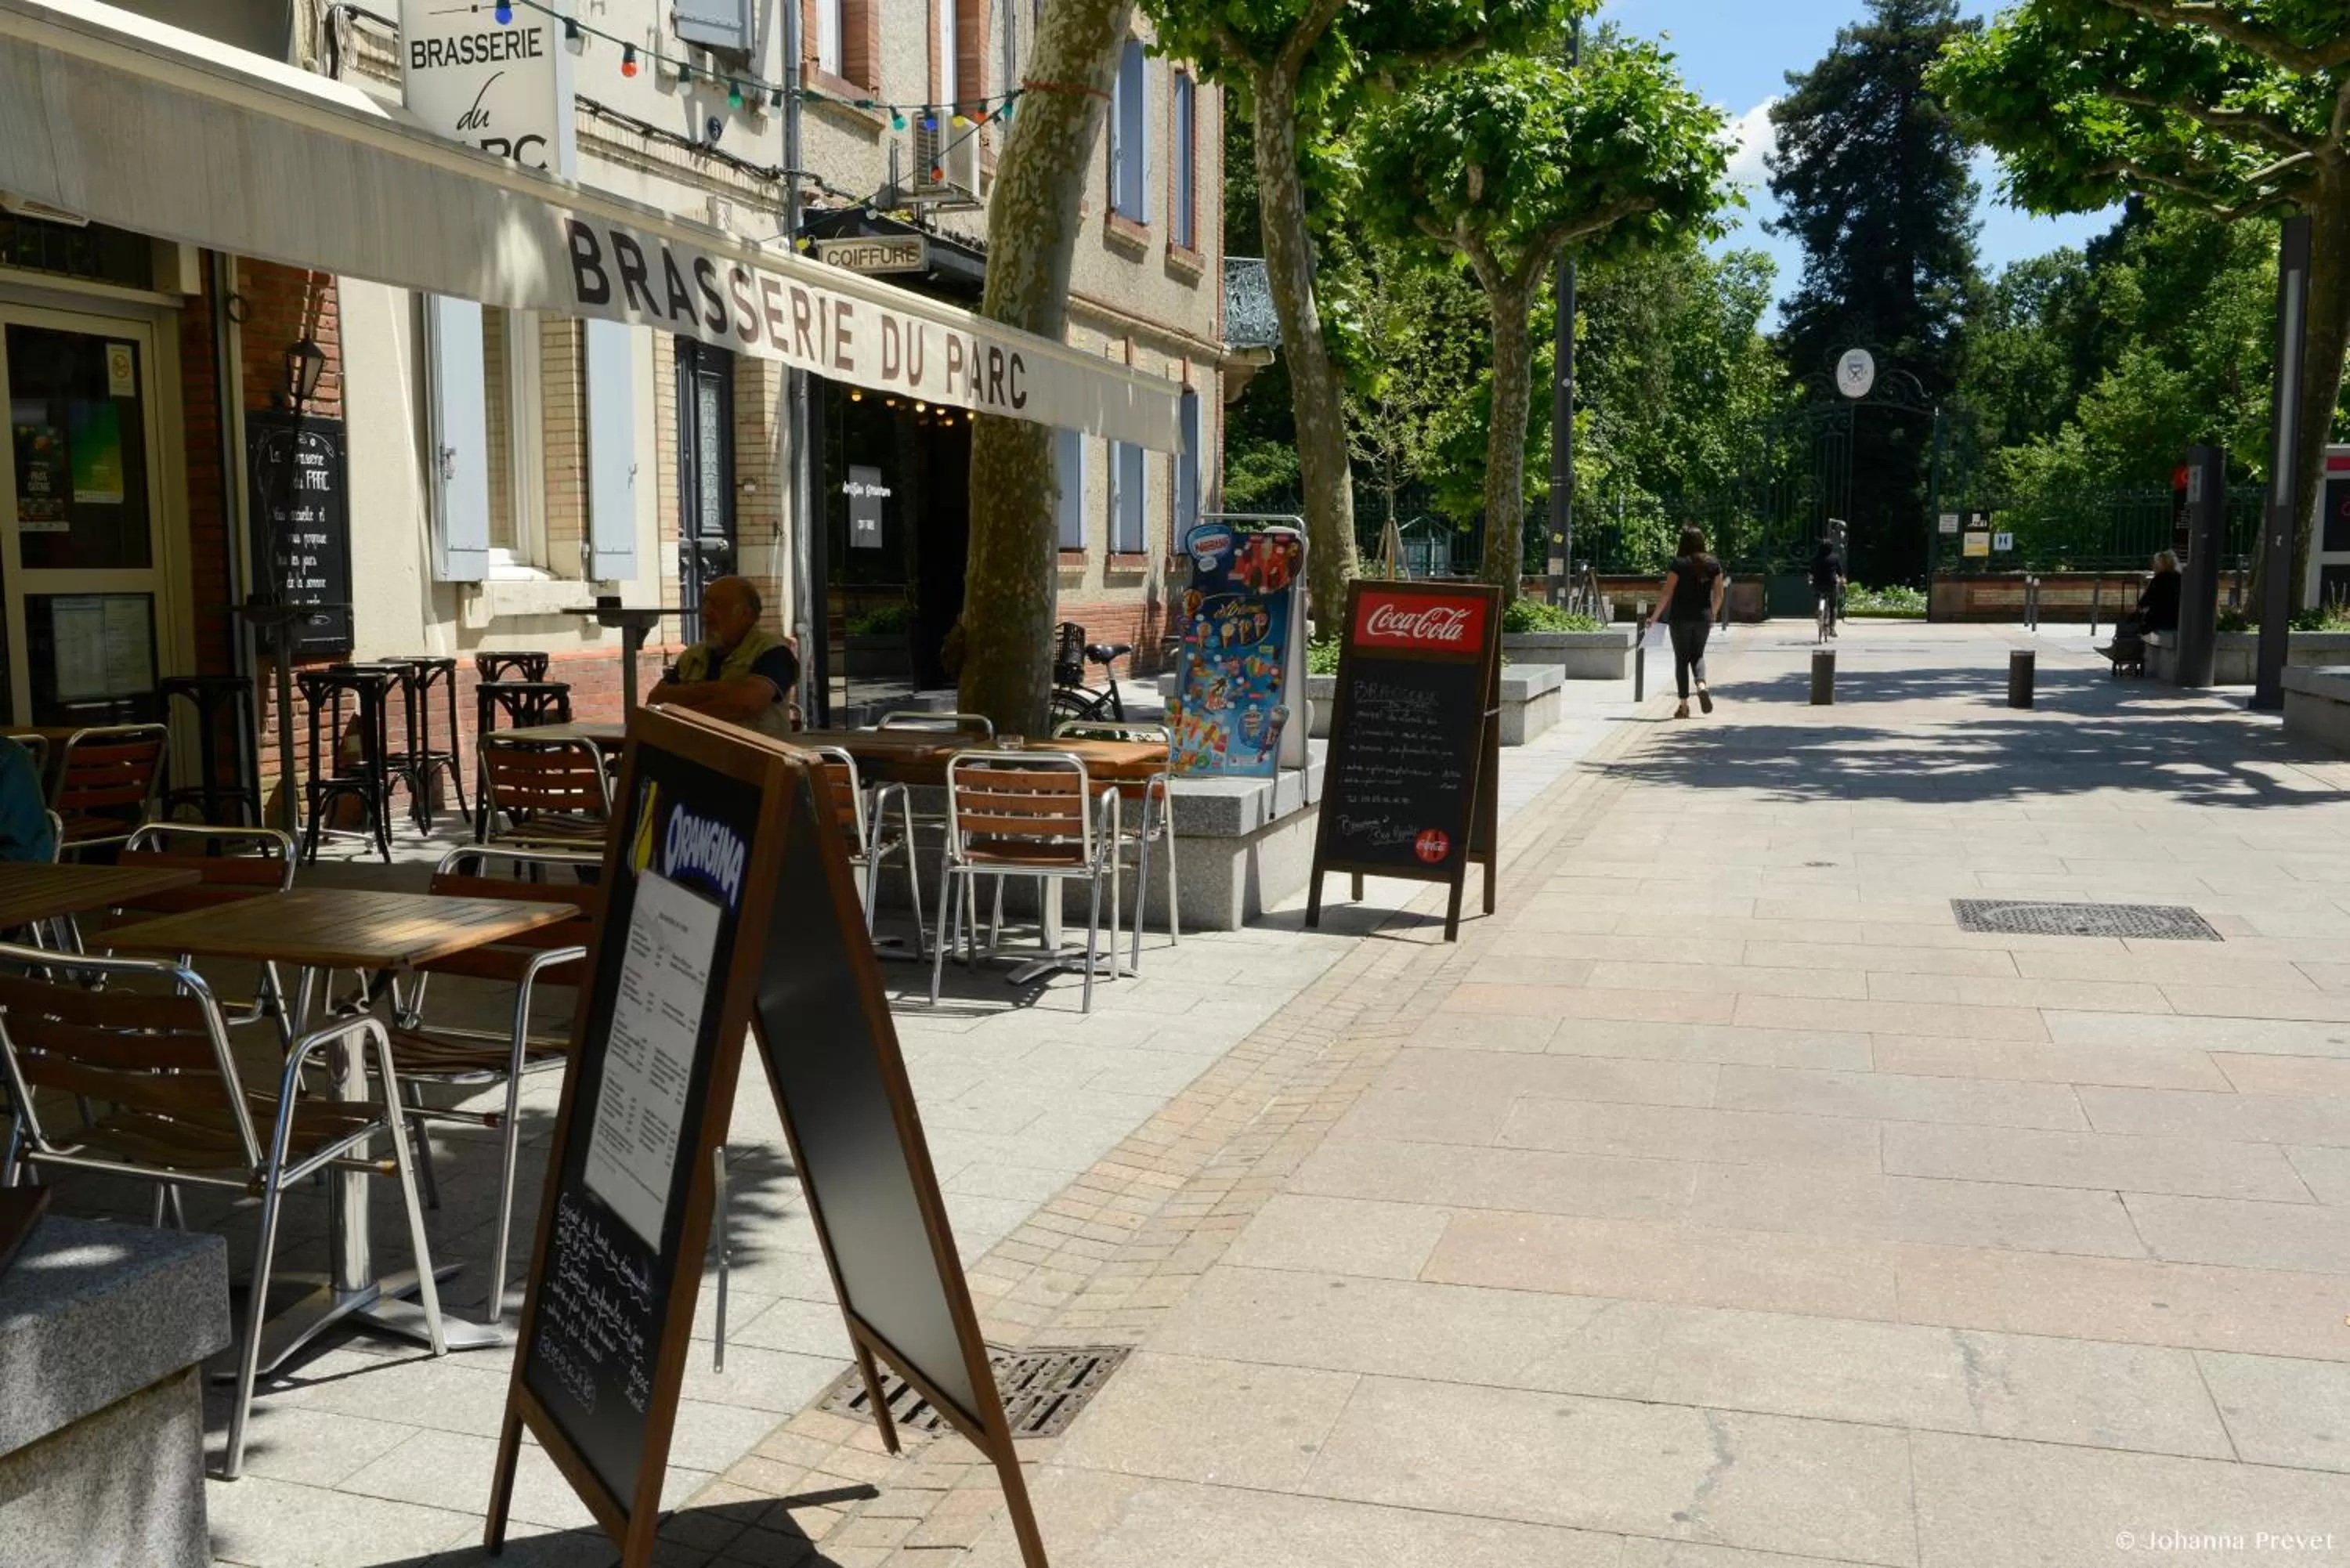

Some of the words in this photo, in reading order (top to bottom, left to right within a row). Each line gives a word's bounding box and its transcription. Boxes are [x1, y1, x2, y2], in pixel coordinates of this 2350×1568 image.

[410, 27, 543, 70] BRASSERIE
[457, 70, 504, 131] du
[827, 241, 920, 266] COIFFURE
[564, 217, 855, 372] BRASSERIE
[880, 316, 924, 388] DU
[945, 333, 1028, 410] PARC
[1366, 603, 1473, 641] Coca-Cola
[664, 803, 745, 909] ORANGINA
